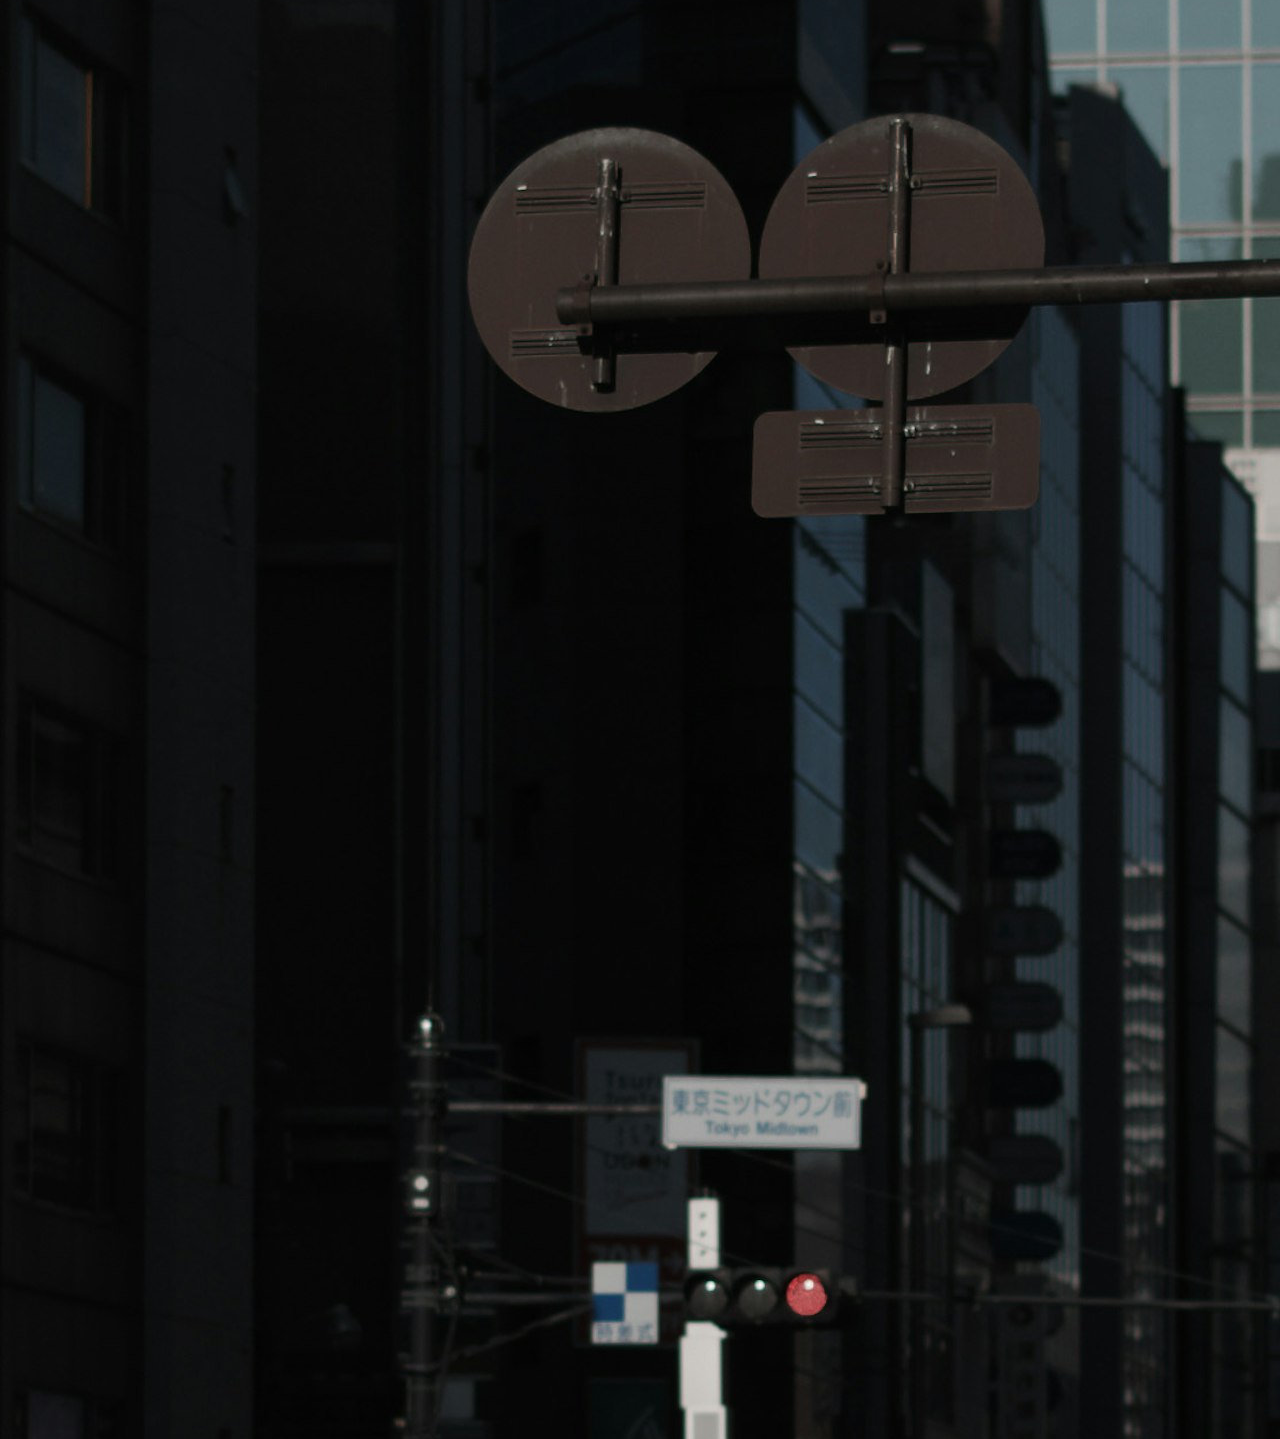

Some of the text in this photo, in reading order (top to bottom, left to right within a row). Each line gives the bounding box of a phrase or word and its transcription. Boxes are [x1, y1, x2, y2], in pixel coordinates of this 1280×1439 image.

[671, 1089, 852, 1119] 東京ミッドタウン前
[706, 1120, 819, 1138] Tokyo Midtown
